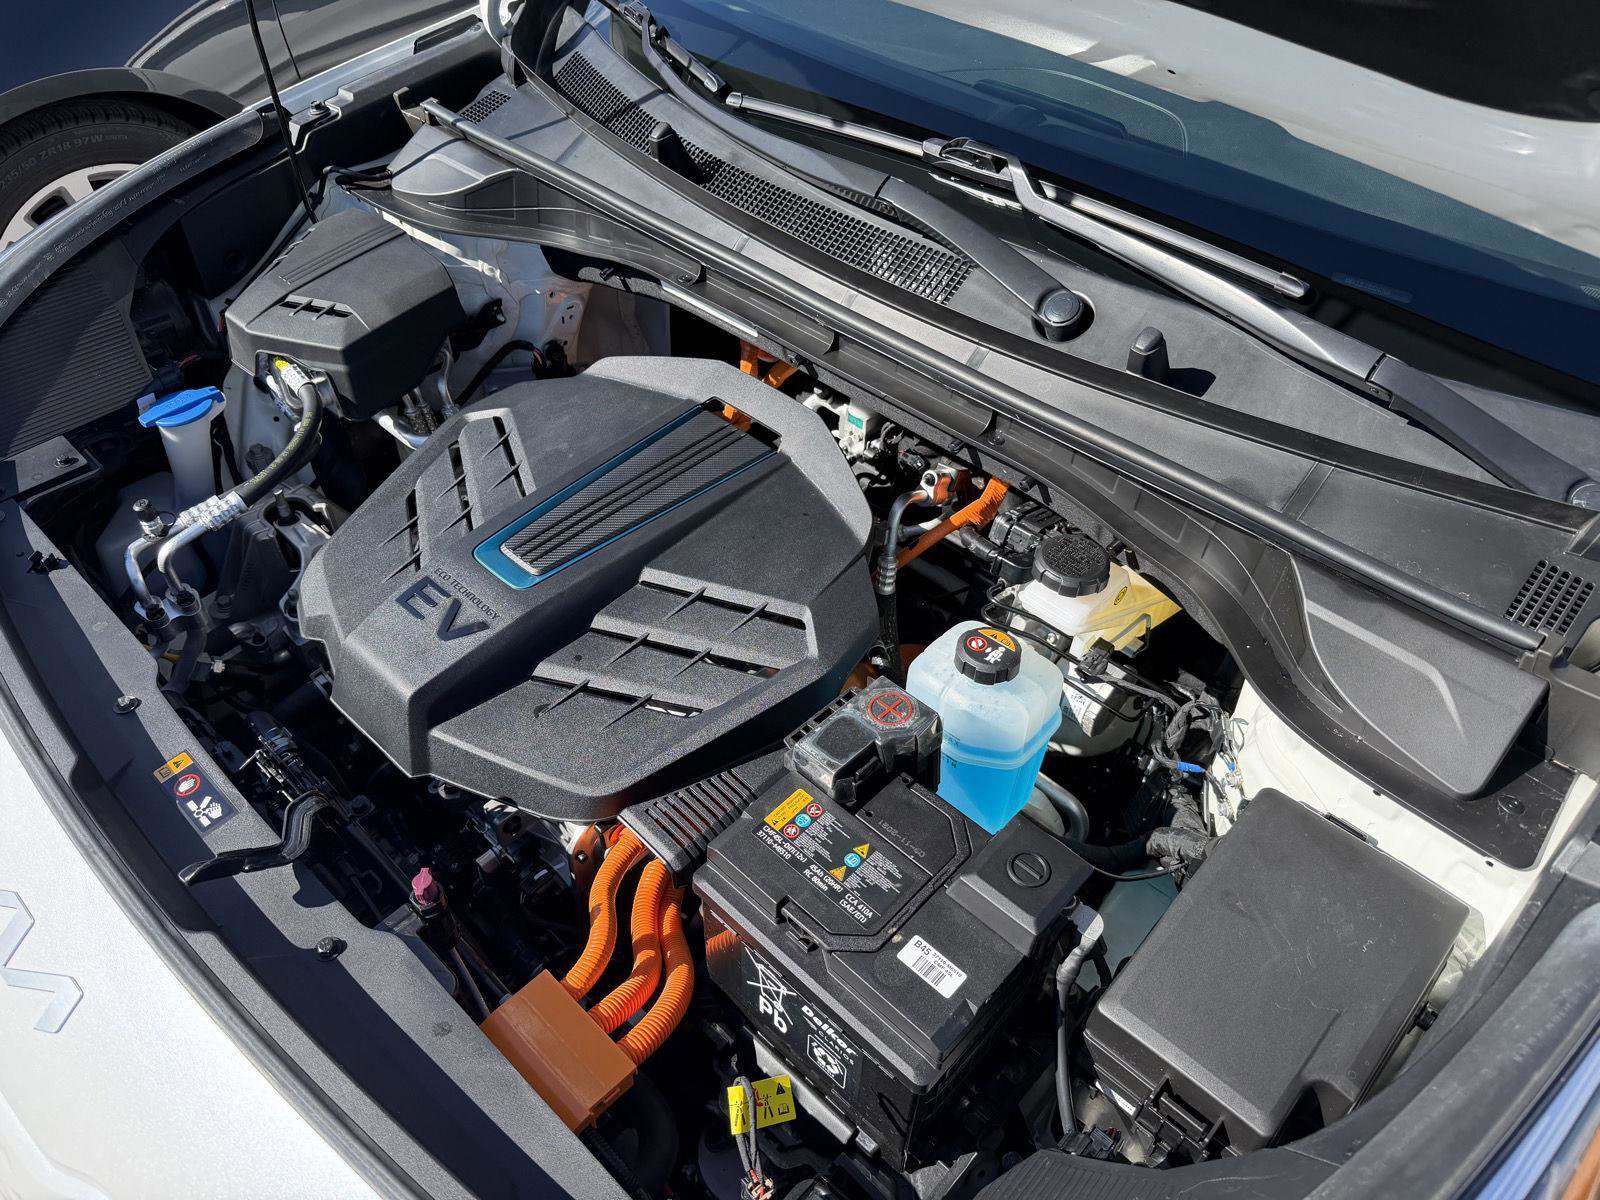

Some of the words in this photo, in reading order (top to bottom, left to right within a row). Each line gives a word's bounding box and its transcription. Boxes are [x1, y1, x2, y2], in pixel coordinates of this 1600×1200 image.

[395, 576, 490, 641] EV
[434, 567, 451, 581] ECO
[450, 579, 501, 621] TECHNOLOGY
[803, 869, 814, 879] RC
[811, 876, 829, 892] 80min
[809, 864, 824, 878] 45Ah
[823, 876, 843, 893] (20HR)
[845, 893, 857, 906] CCA
[857, 903, 873, 918] 410A
[914, 939, 932, 956] B45
[759, 994, 788, 1034] Pb
[801, 1005, 859, 1057] Delkor
[818, 1030, 855, 1066] CLARIOS
